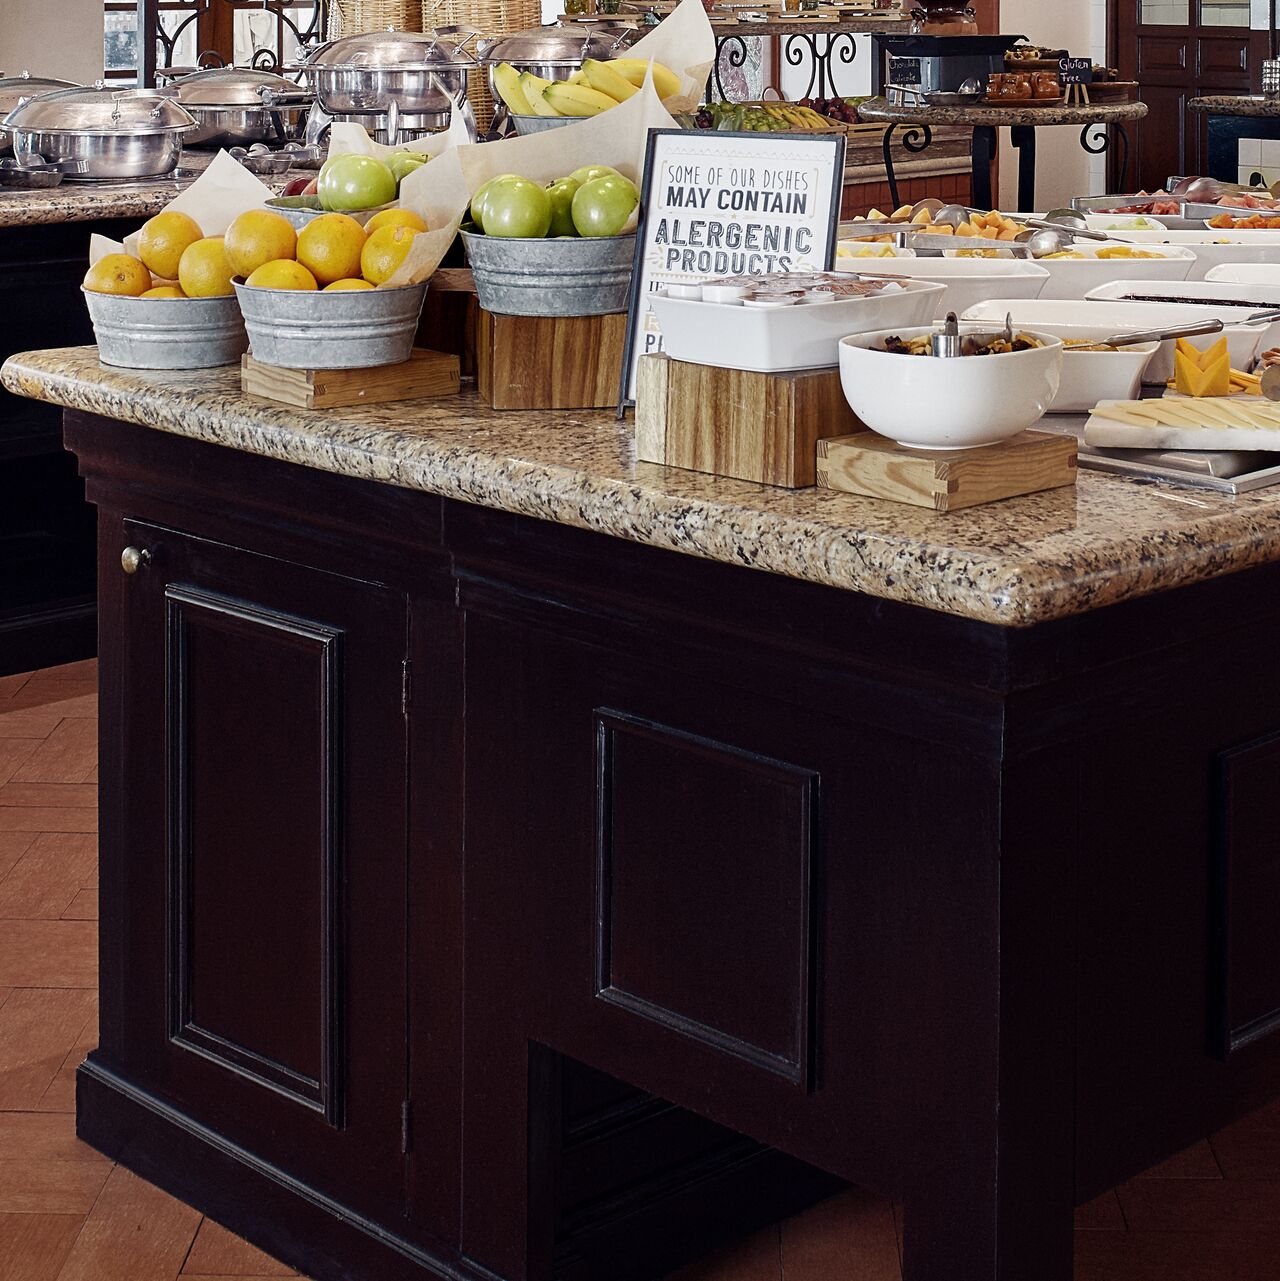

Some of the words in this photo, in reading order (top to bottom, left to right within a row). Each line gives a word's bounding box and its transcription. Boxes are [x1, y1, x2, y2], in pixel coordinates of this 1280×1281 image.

[1059, 58, 1089, 70] Gluten
[668, 165, 701, 185] SOME
[707, 166, 723, 185] OF
[730, 167, 756, 188] OUR
[763, 169, 809, 191] DISHES
[666, 186, 711, 209] MAY
[717, 188, 807, 215] CONTAIN
[655, 218, 813, 254] ALERGENIC
[666, 248, 793, 275] PRODUCTS
